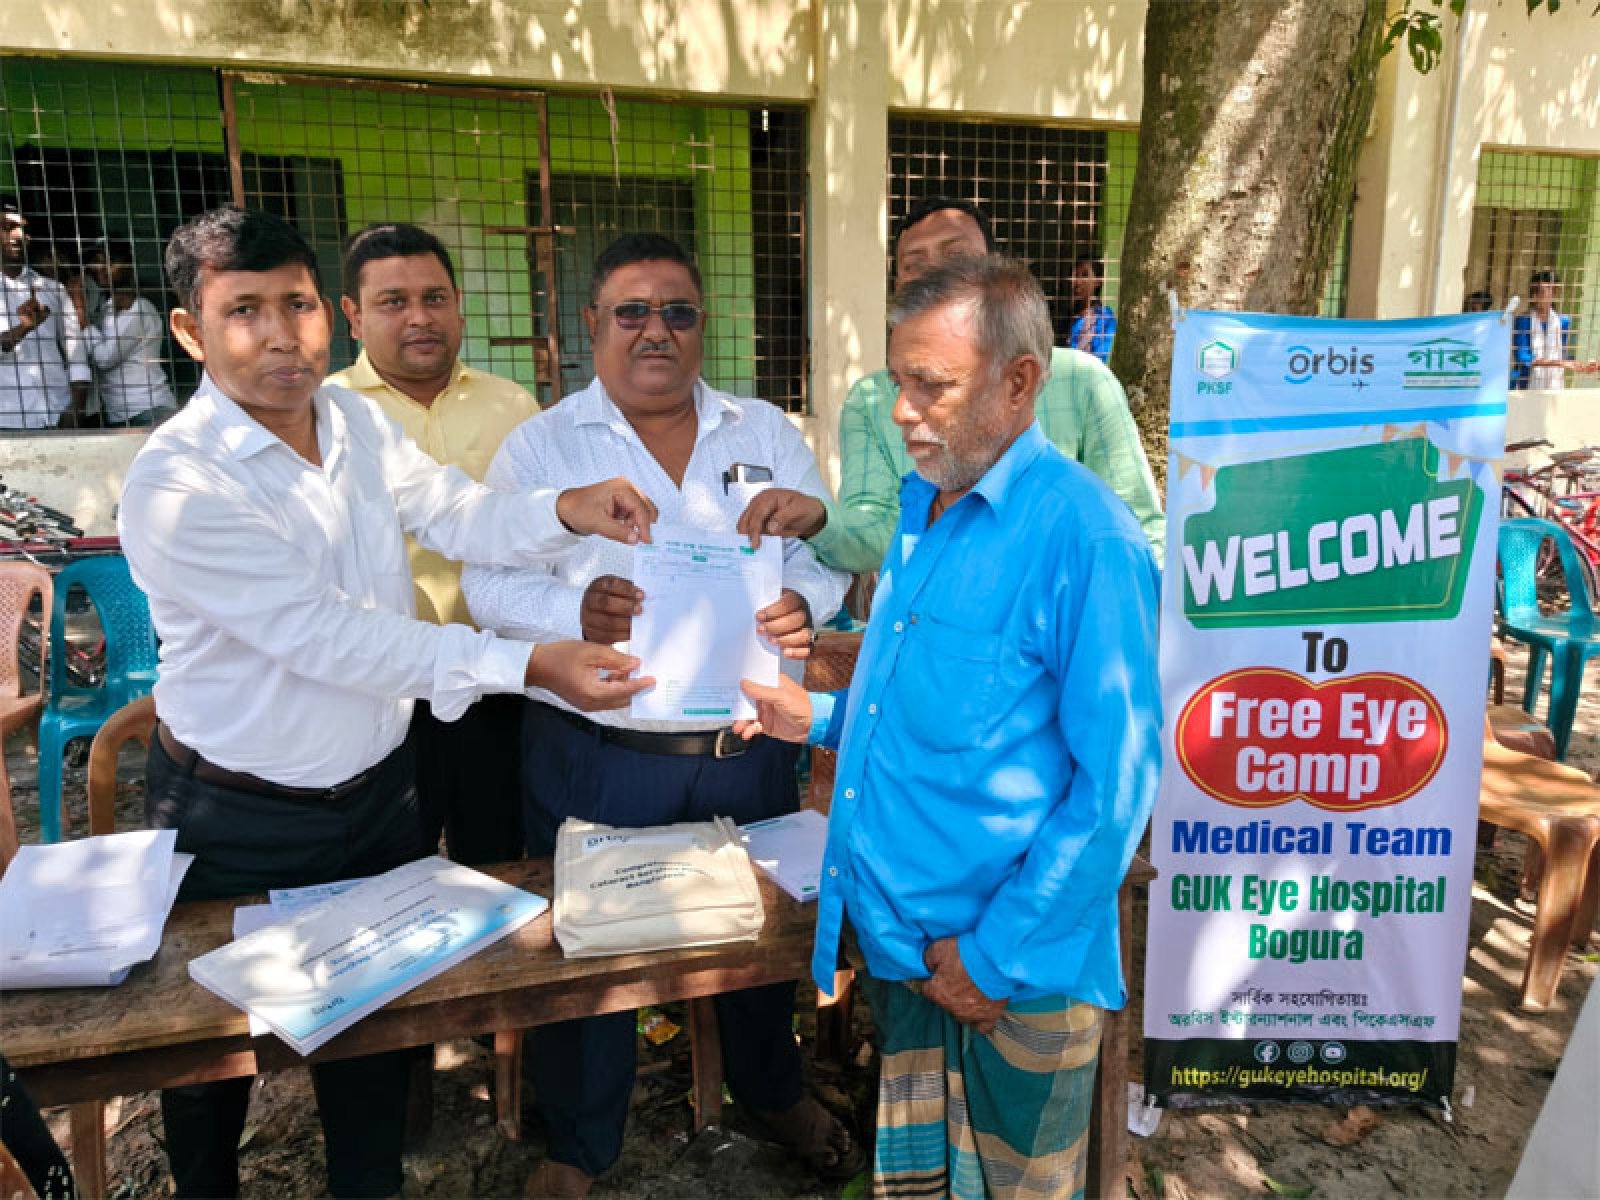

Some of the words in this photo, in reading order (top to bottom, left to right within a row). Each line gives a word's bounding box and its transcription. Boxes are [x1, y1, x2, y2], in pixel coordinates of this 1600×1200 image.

[1289, 346, 1375, 376] orbis
[1407, 347, 1480, 370] গাক
[1197, 381, 1233, 395] PKSF
[1183, 495, 1462, 607] WELCOME
[1302, 632, 1349, 673] To
[1208, 691, 1322, 739] Free
[1338, 693, 1427, 746] Eye
[1235, 746, 1380, 800] Camp
[1171, 820, 1332, 855] Medical
[1347, 822, 1453, 857] Team
[1171, 873, 1230, 912] GUK
[1241, 875, 1299, 917] Eye
[1309, 875, 1447, 918] Hospital
[1248, 924, 1364, 963] Bogura
[1318, 1013, 1349, 1029] এবং
[1171, 1065, 1429, 1092] https://gukeyehospital.org/
